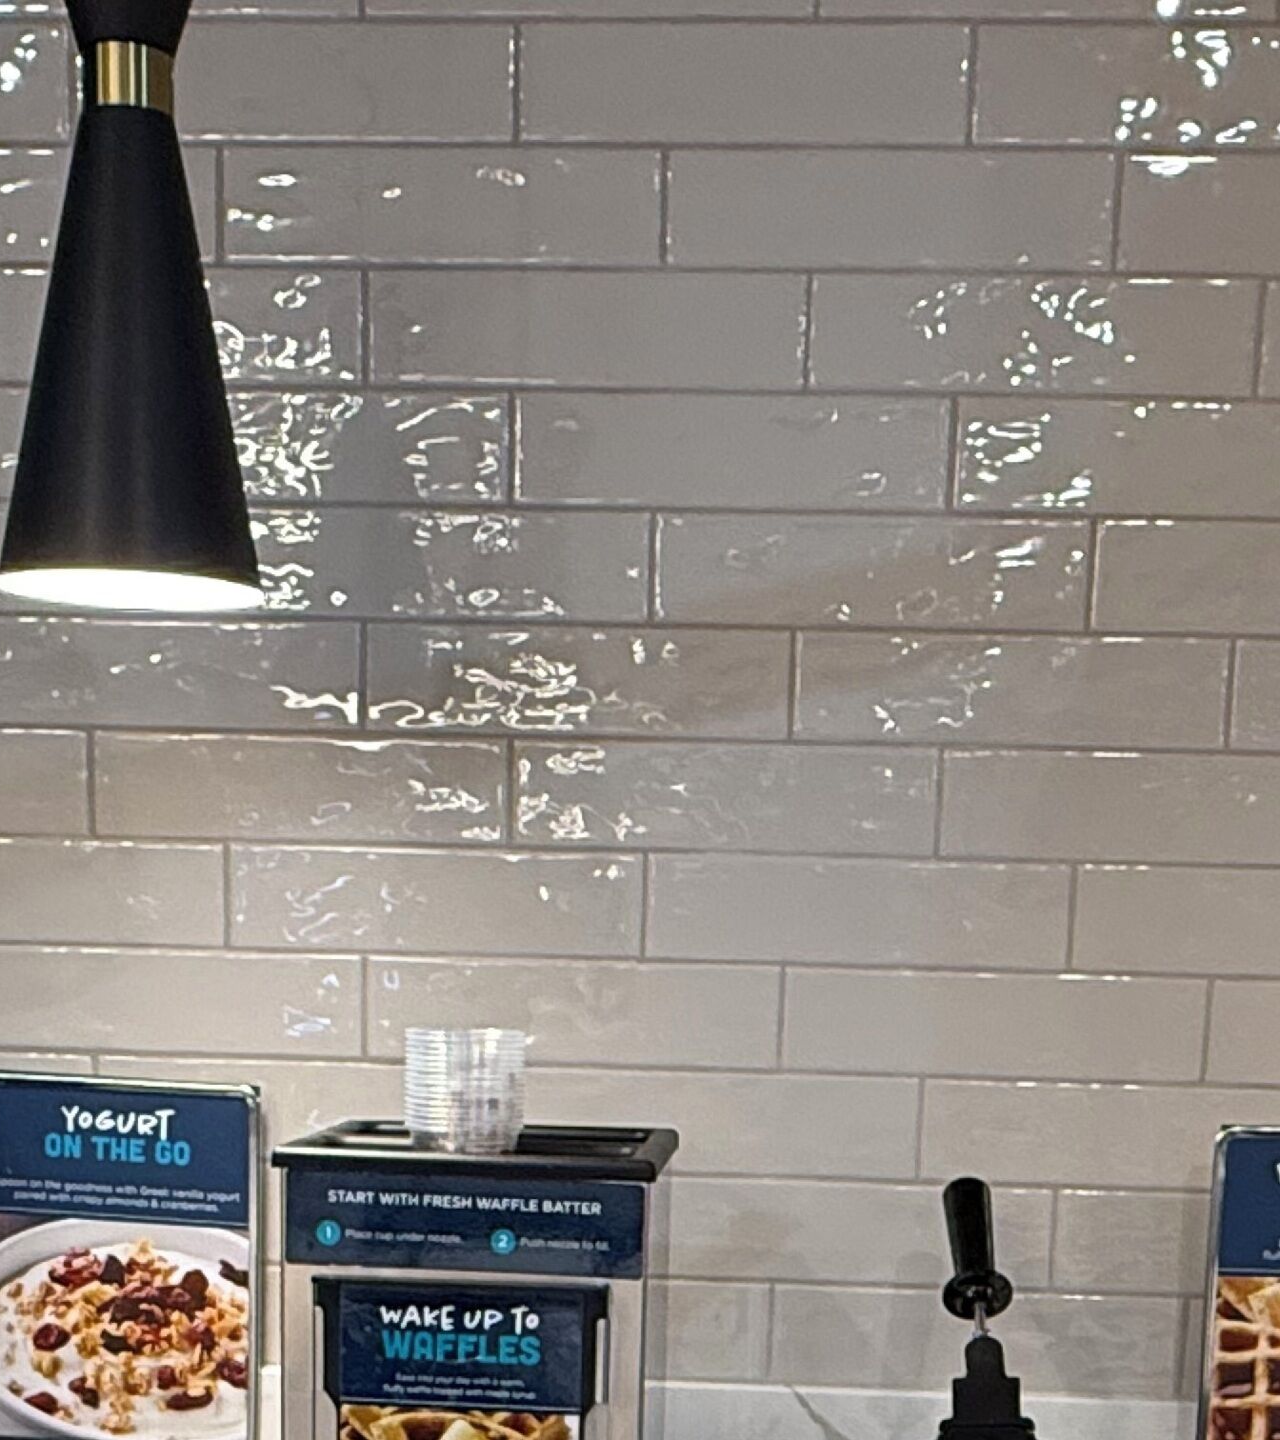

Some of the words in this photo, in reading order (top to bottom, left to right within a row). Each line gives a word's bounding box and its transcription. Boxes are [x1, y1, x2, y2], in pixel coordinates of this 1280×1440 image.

[61, 1105, 176, 1141] YOGURT
[44, 1132, 82, 1159] ON
[90, 1136, 146, 1163] THE
[154, 1140, 191, 1166] GO
[64, 1183, 113, 1194] goodness
[115, 1185, 138, 1195] with
[206, 1192, 240, 1204] yogurt
[327, 1189, 375, 1204] START
[379, 1192, 419, 1206] WITH
[423, 1194, 472, 1209] FRESH
[476, 1196, 539, 1213] WAFFLE
[542, 1199, 602, 1216] BATTER
[497, 1234, 510, 1248] 2
[463, 1309, 503, 1331] UP
[381, 1330, 541, 1366] WAFFLES
